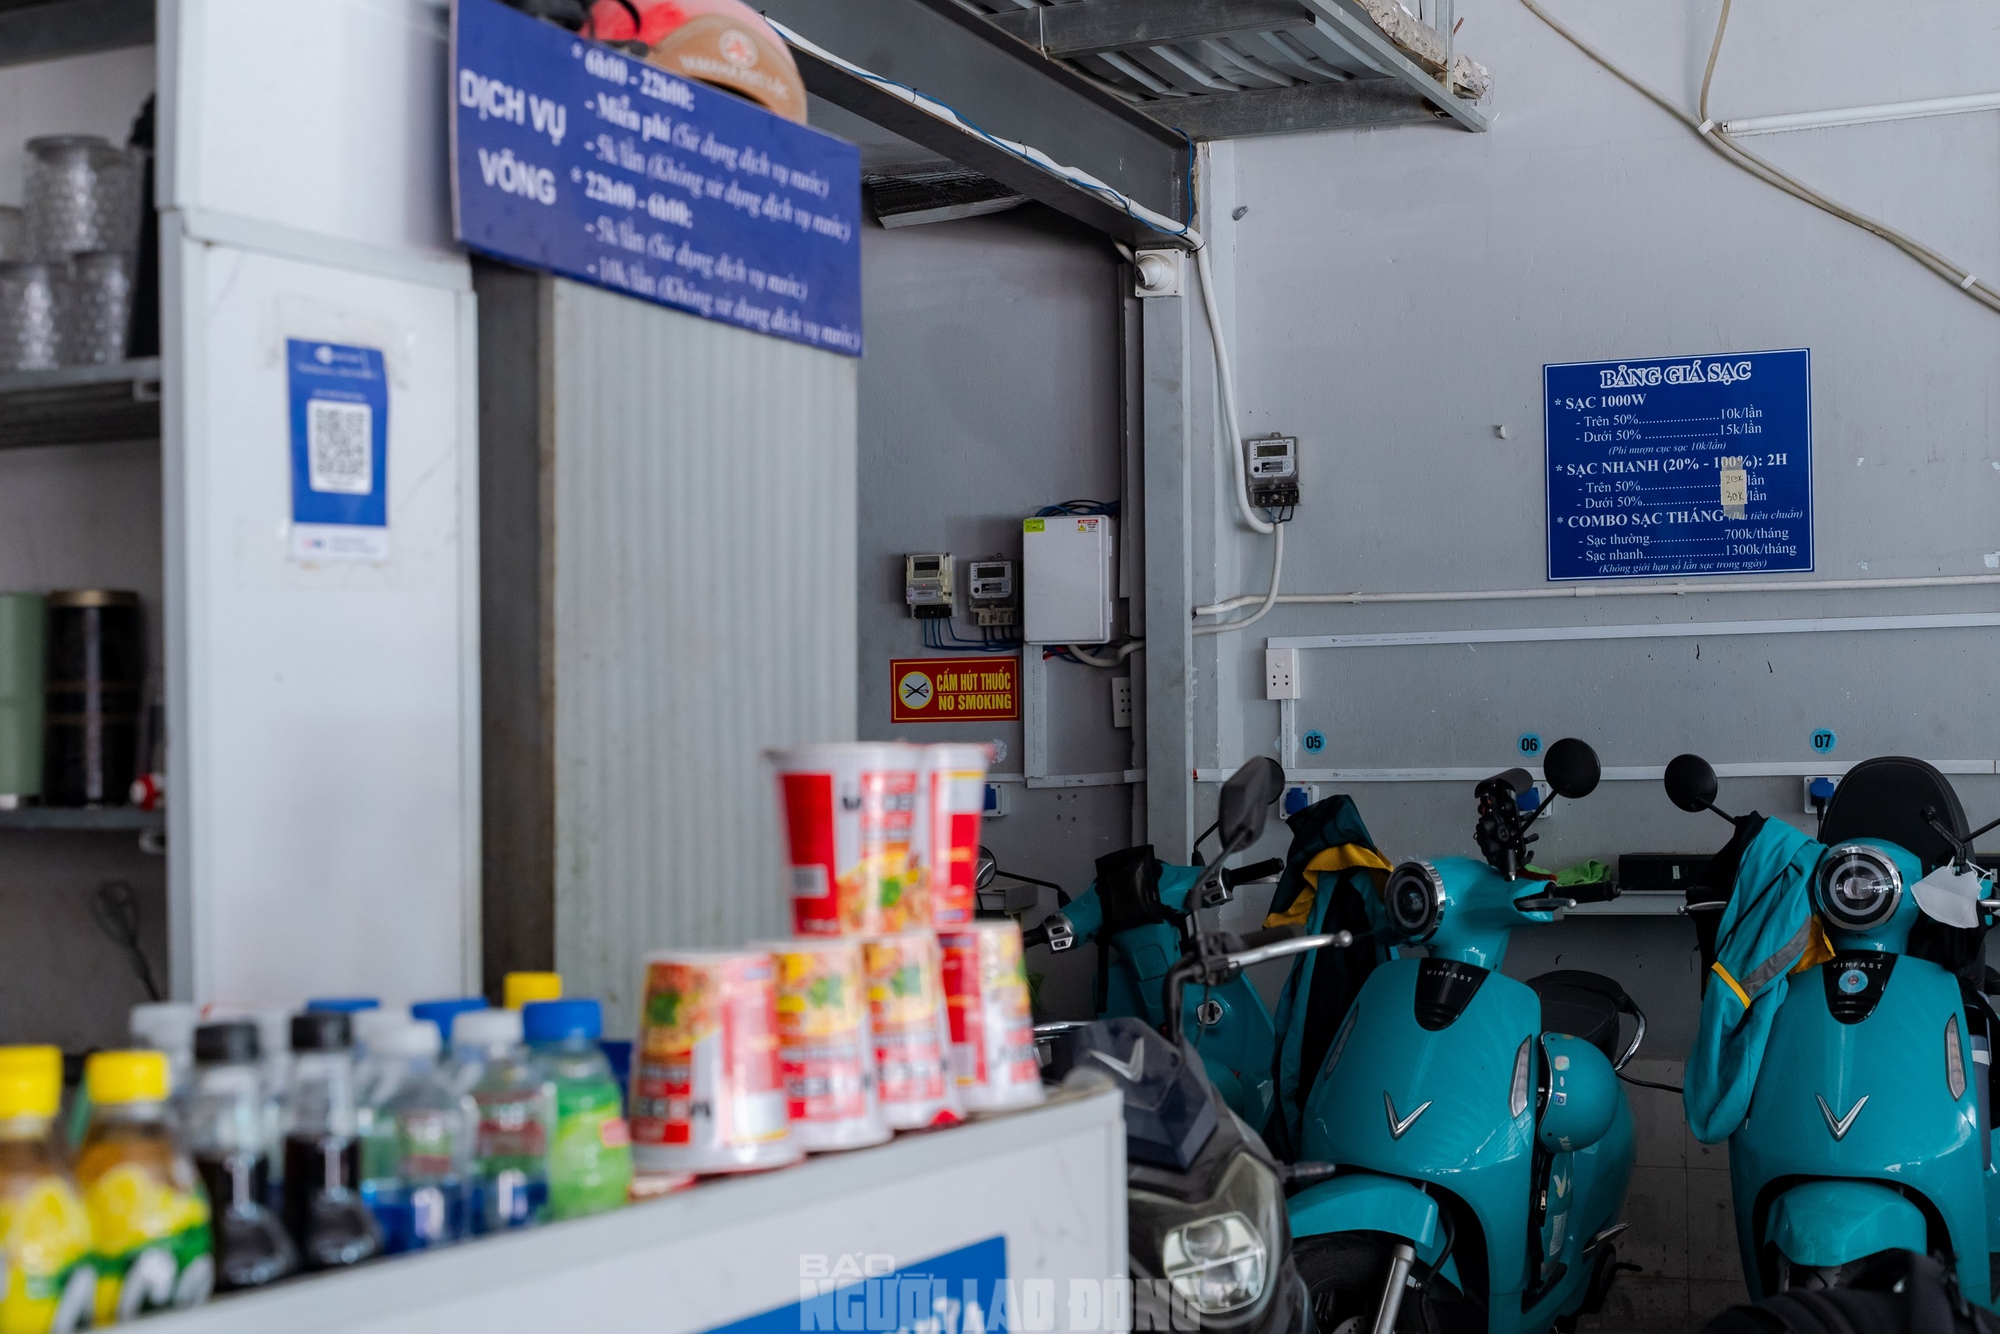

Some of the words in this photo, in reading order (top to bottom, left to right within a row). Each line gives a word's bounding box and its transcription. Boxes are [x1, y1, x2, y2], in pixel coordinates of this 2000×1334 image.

[459, 68, 525, 126] DỊCH
[528, 93, 566, 147] VỤ
[1600, 365, 1662, 389] BẢNG
[1664, 359, 1706, 385] GIÁ
[1708, 361, 1751, 386] SẠC
[1566, 396, 1596, 412] SẠC
[1601, 393, 1646, 408] 1000W
[1584, 415, 1609, 427] Trên
[1584, 430, 1612, 444] Dưới
[1616, 429, 1641, 442] 50%
[1673, 444, 1688, 453] sạc
[1567, 462, 1597, 478] SẠC
[1602, 459, 1659, 474] NHANH
[1663, 457, 1699, 473] (20%
[1767, 453, 1788, 466] 2H
[1585, 482, 1611, 493] Trên
[1585, 496, 1613, 509] Dưới
[1567, 513, 1628, 528] COMBO
[1631, 512, 1663, 528] SẠC
[1666, 507, 1724, 524] THÁNG
[1586, 534, 1607, 548] Sạc
[1610, 533, 1650, 547] thường
[1724, 527, 1789, 541] 700k/tháng
[1585, 550, 1606, 563] Sạc
[1609, 548, 1643, 561] nhanh
[1726, 542, 1797, 557] 1300k/tháng
[1716, 560, 1740, 569] trong
[936, 667, 958, 692] CẤM
[960, 669, 978, 691] HÚT
[980, 666, 1011, 691] THUỐC
[938, 694, 955, 711] NO
[958, 693, 1012, 711] SMOKING
[1305, 735, 1322, 749] 05
[1521, 738, 1538, 751] 06
[1814, 734, 1831, 748] 07
[1832, 962, 1882, 970] VINFAST
[1426, 970, 1473, 982] VINFAST
